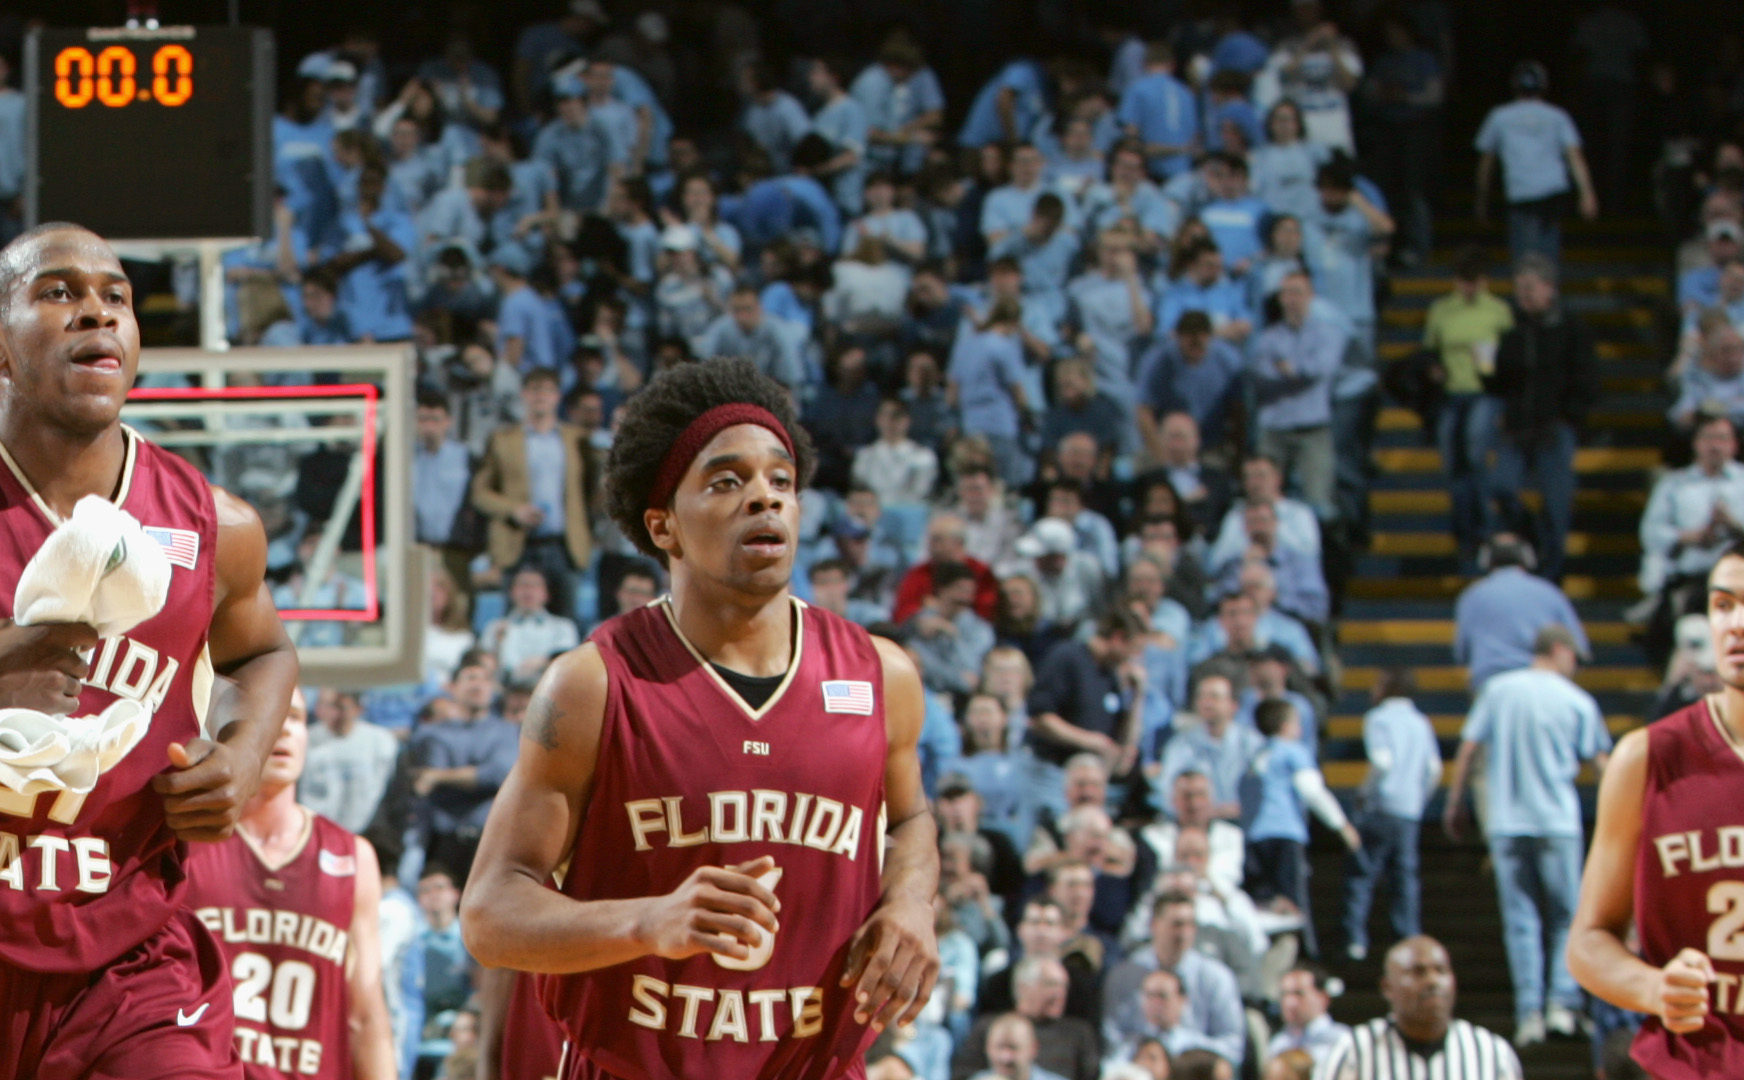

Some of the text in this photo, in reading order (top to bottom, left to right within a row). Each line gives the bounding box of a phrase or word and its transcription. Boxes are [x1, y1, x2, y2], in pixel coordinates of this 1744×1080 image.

[55, 44, 193, 108] 00.0
[743, 740, 770, 756] FSU
[624, 789, 864, 861] FLORIDA
[194, 906, 347, 967] FLORIDA
[231, 951, 317, 1030] 20
[628, 974, 824, 1043] STATE
[234, 1026, 323, 1075] TATE
